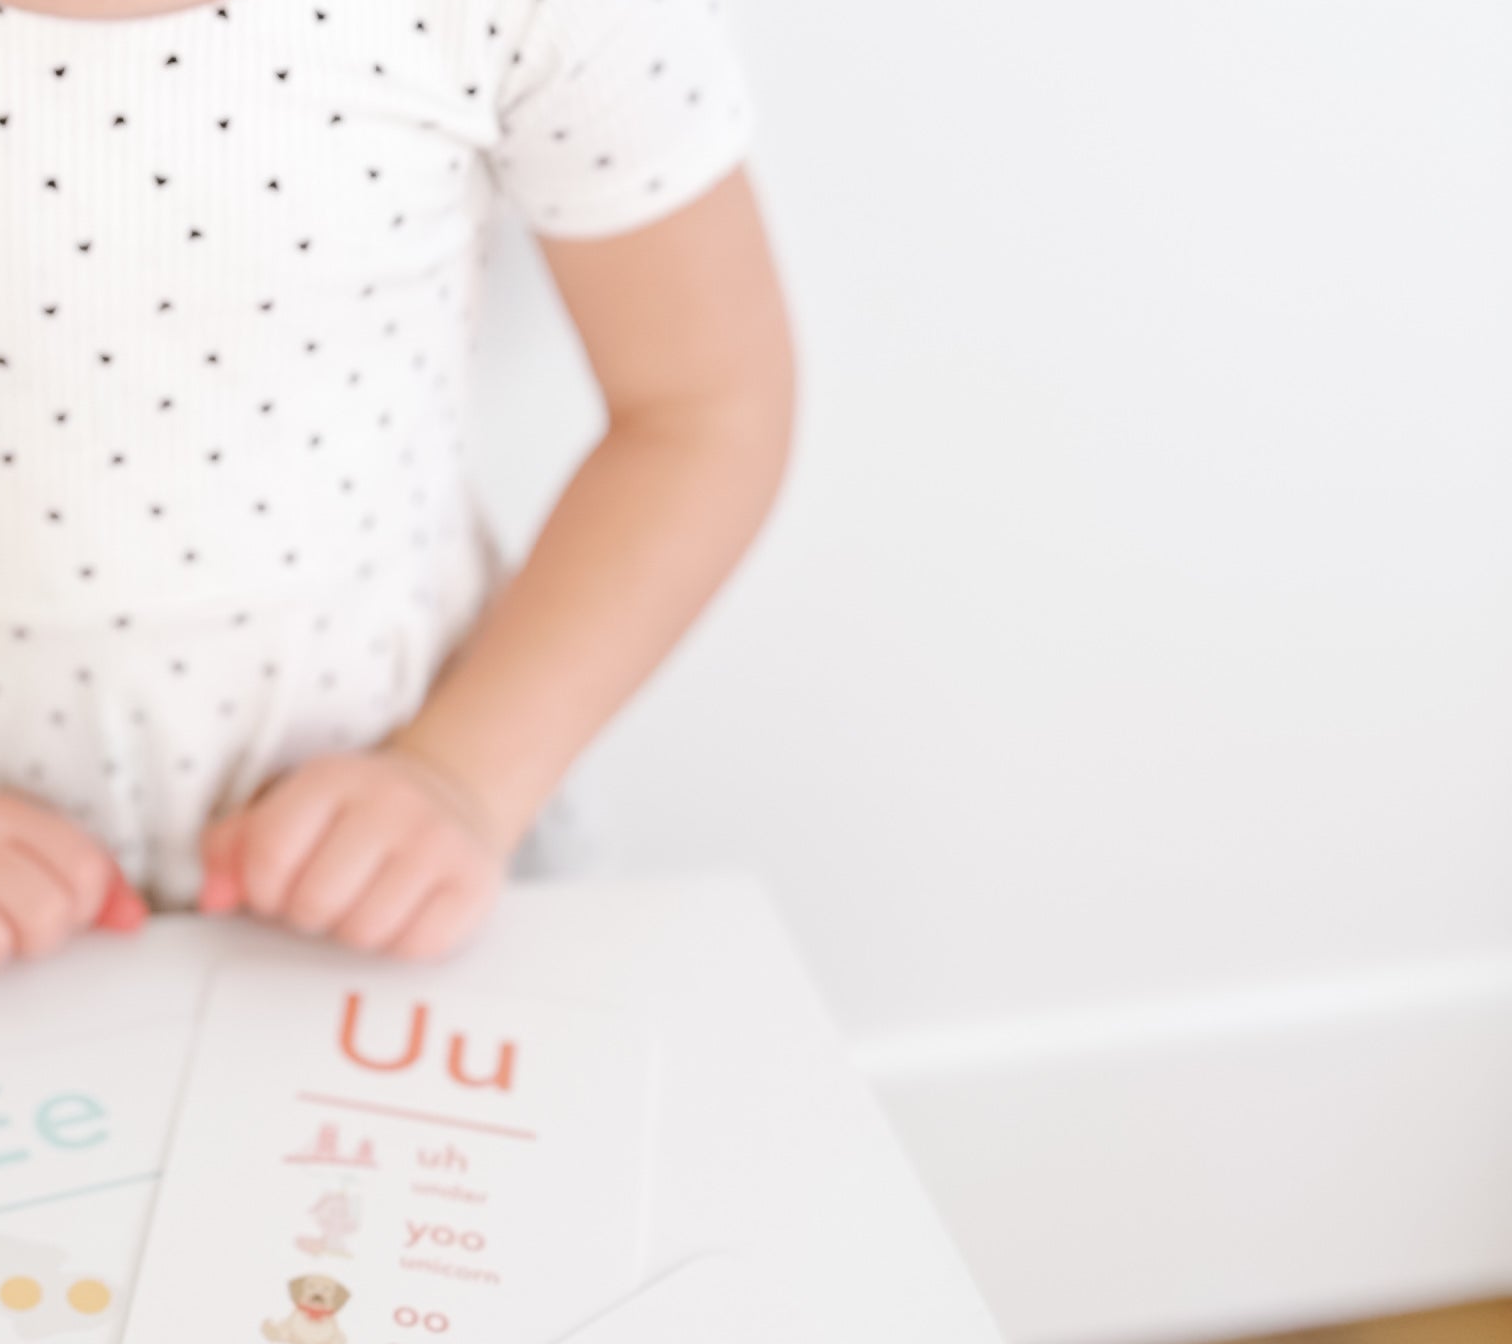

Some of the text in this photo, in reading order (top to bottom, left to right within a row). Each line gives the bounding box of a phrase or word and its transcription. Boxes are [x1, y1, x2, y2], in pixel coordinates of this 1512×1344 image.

[337, 988, 516, 1092] Uu
[416, 1144, 469, 1173] uh
[404, 1221, 486, 1252] yoo
[392, 1306, 450, 1334] oo
